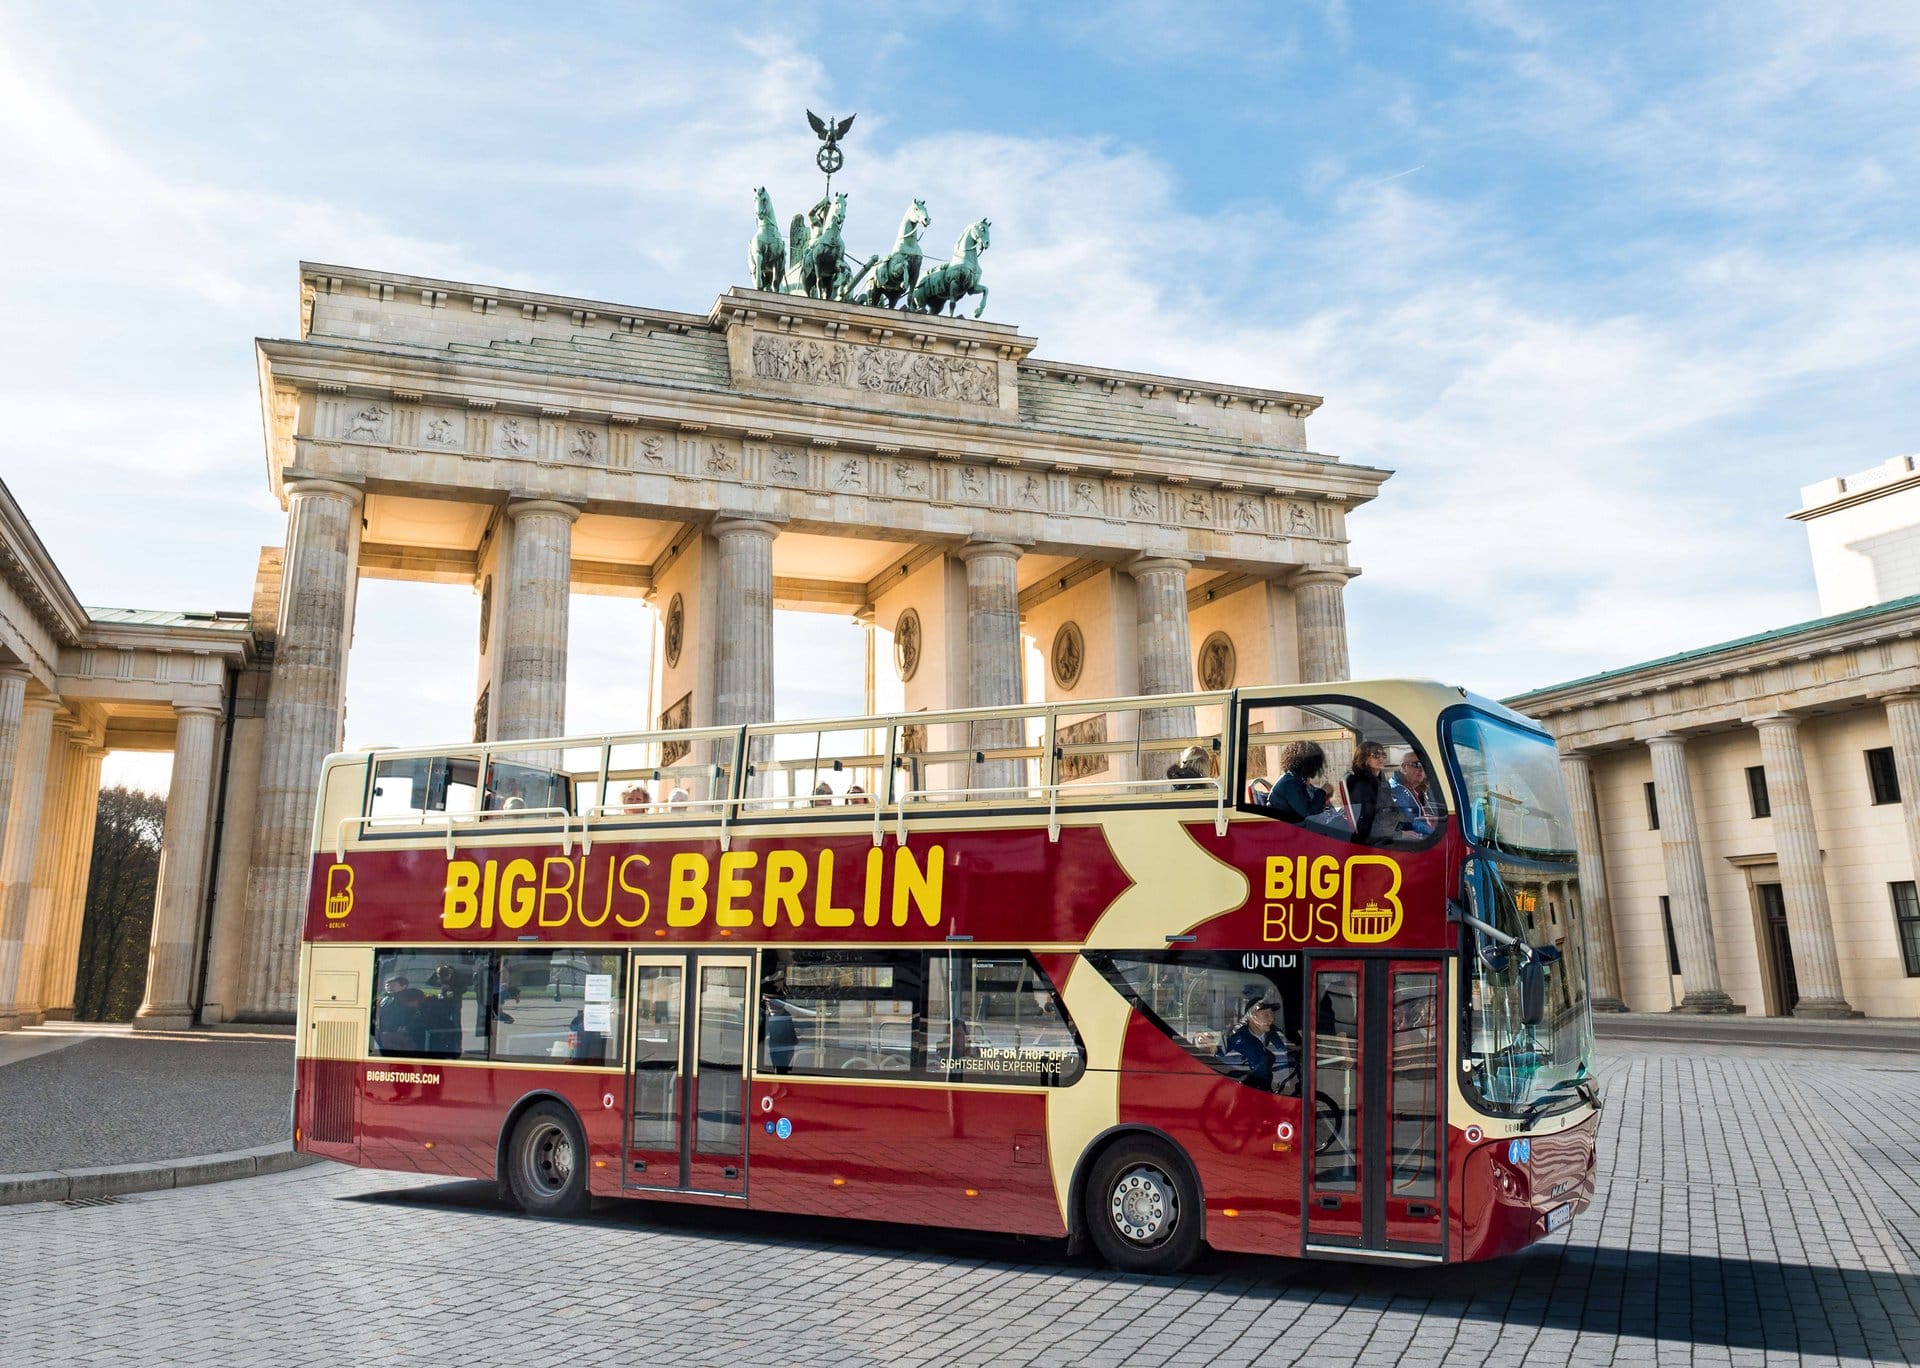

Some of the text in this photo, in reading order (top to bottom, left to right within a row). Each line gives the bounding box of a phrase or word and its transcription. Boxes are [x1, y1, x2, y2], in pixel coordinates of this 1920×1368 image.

[443, 845, 944, 928] BIGBUS BERLIN
[1265, 855, 1340, 899] BIG
[1263, 903, 1338, 942] BUS
[940, 1058, 1061, 1073] SIGHTSEEING EXPERIENCE
[980, 1048, 1017, 1059] HOP-ON
[1025, 1050, 1068, 1061] HOP-OFF
[366, 1070, 440, 1084] BIGBUSTOURS.COM
